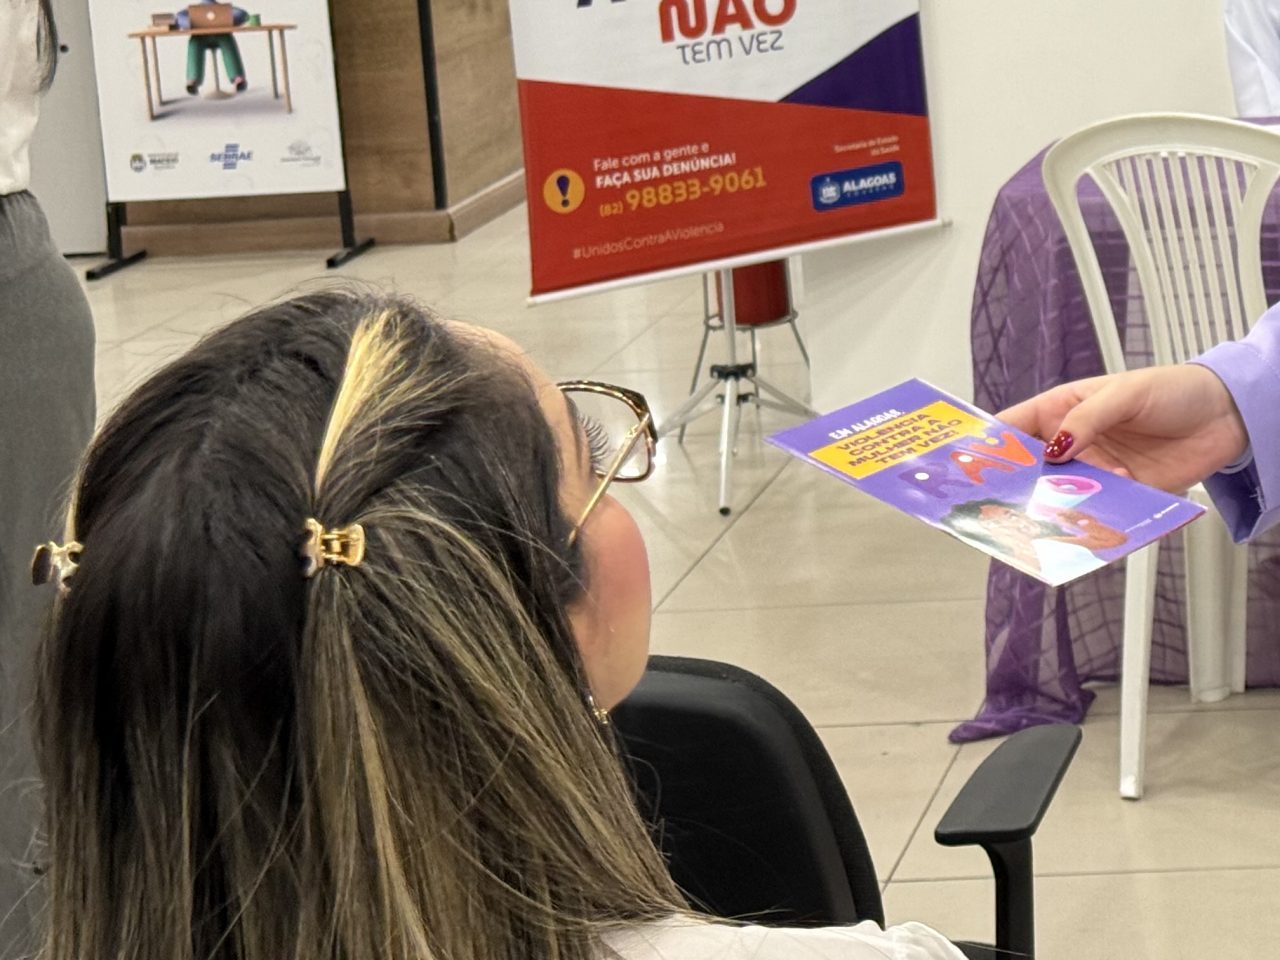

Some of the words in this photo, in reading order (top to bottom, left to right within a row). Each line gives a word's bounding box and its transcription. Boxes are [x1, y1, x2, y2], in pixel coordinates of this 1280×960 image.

[676, 40, 734, 67] TEM
[738, 29, 785, 55] VEZ
[209, 150, 254, 163] SEBRAE
[593, 157, 620, 172] Fale
[621, 151, 650, 167] com
[653, 150, 662, 161] a
[664, 143, 700, 161] gente
[701, 142, 710, 153] e
[596, 171, 632, 190] FAÇA
[633, 165, 662, 183] SUA
[662, 151, 738, 177] DENÚNCIA!
[599, 201, 624, 218] (82)
[625, 166, 767, 212] 98833-9061
[842, 171, 897, 193] ALAGOAS
[829, 426, 853, 440] EM
[848, 424, 926, 456] CONTRA
[848, 434, 922, 467] MULHER
[875, 447, 917, 465] TEM
